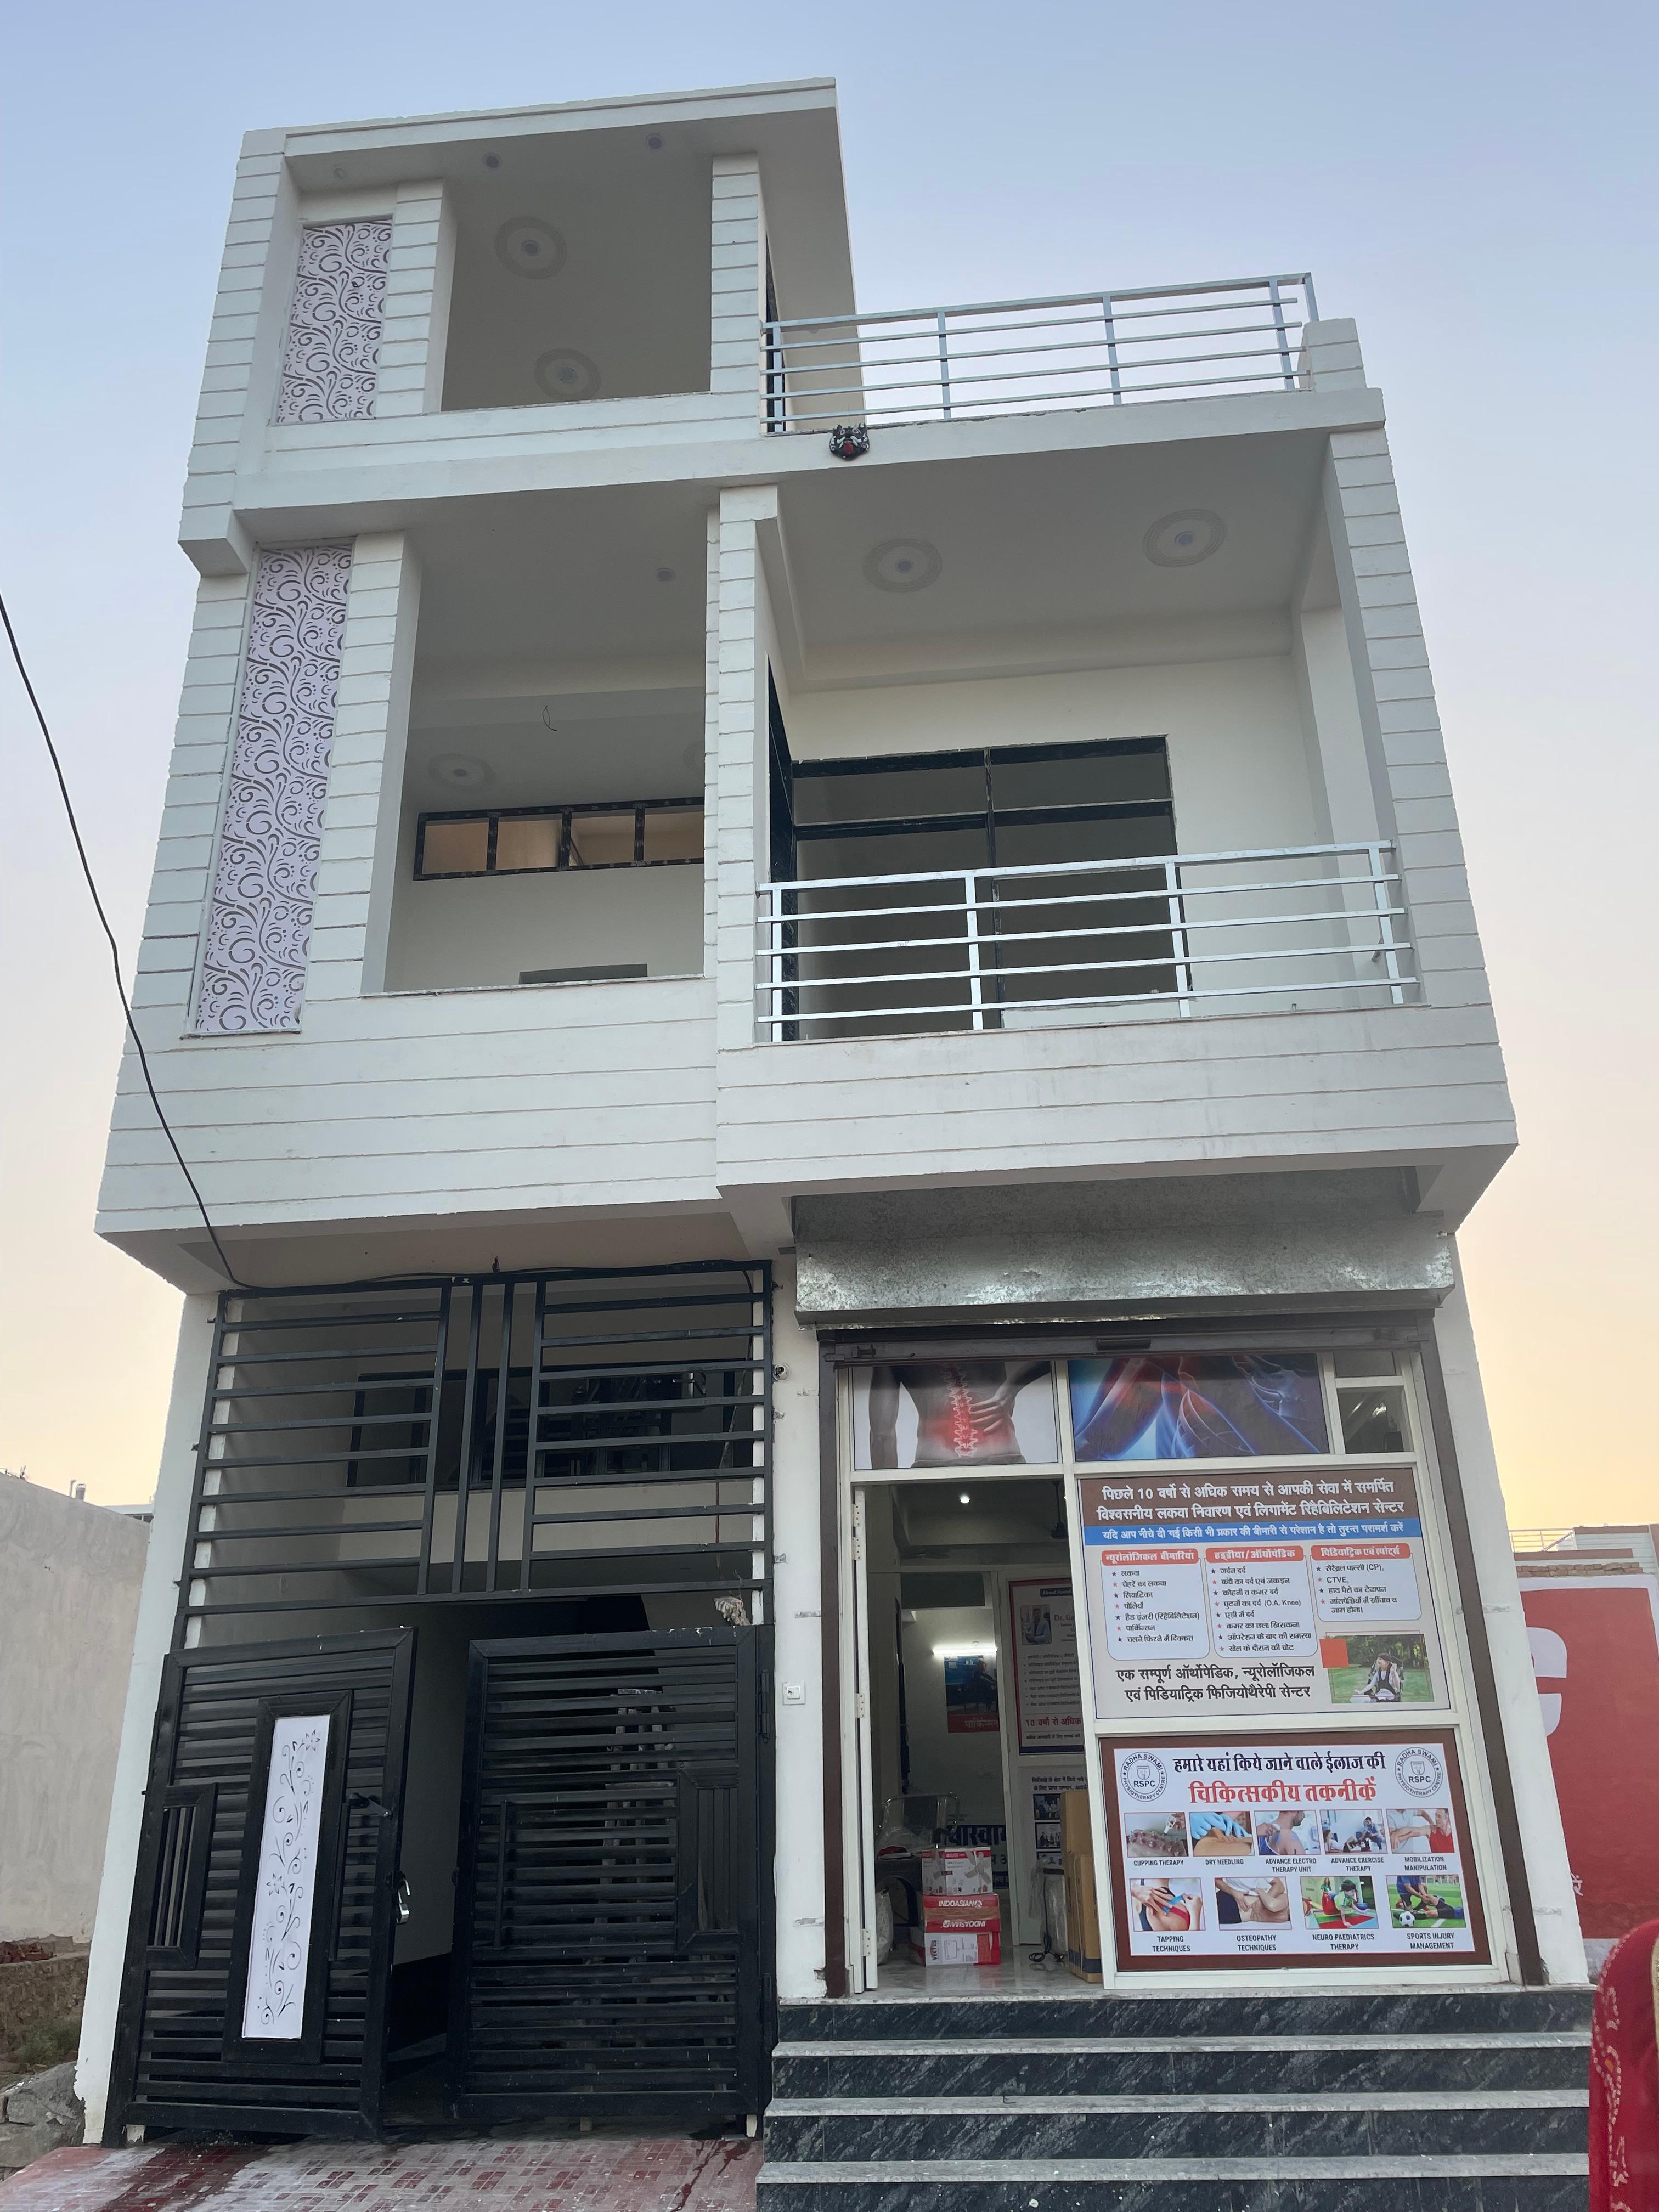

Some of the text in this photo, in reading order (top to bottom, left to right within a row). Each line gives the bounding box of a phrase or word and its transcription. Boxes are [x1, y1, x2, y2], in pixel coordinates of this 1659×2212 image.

[1102, 1485, 1133, 1500] पिछले
[1138, 1488, 1153, 1499] 10
[1180, 1483, 1190, 1498] से
[1194, 1483, 1228, 1498] अधिक
[1230, 1485, 1260, 1497] समय
[1262, 1481, 1274, 1496] से
[1277, 1480, 1313, 1496] आपकी
[1317, 1479, 1339, 1494] सेवा
[1342, 1479, 1352, 1494] में
[1354, 1477, 1394, 1493] समर्पित
[1096, 1498, 1404, 1521] विश्वसनीय लकवा निवारण एवं लिगामेंट रिहैबिलिटेशन सेन्टर
[1102, 1521, 1403, 1540] यदि आप नीचे दी गई किसी भी प्रकार की बीमारी से परेशान है तो तुरन्त परामर्श करें
[1116, 1669, 1135, 1683] एक
[1138, 1664, 1171, 1684] सम्पूर्ण
[1241, 1662, 1315, 1682] न्यूरोलॉजिकल
[1125, 1683, 1311, 1702] एवं पिडियाट्रिक फिजियोथैरेपी सेन्टर
[1026, 1719, 1035, 1728] 10
[1123, 1754, 1163, 1771] RADHA SWAMI
[1173, 1751, 1386, 1773] हमारे यहां किये जाने वाले ईलाज की
[1397, 1750, 1438, 1767] RADHA SWAMI
[1122, 1777, 1165, 1799] PHYSIOTHERAPY CENTRE
[1188, 1776, 1376, 1803] चिकित्सकीय तकनीकें
[1397, 1773, 1431, 1796] PHYSIOTHERAPY
